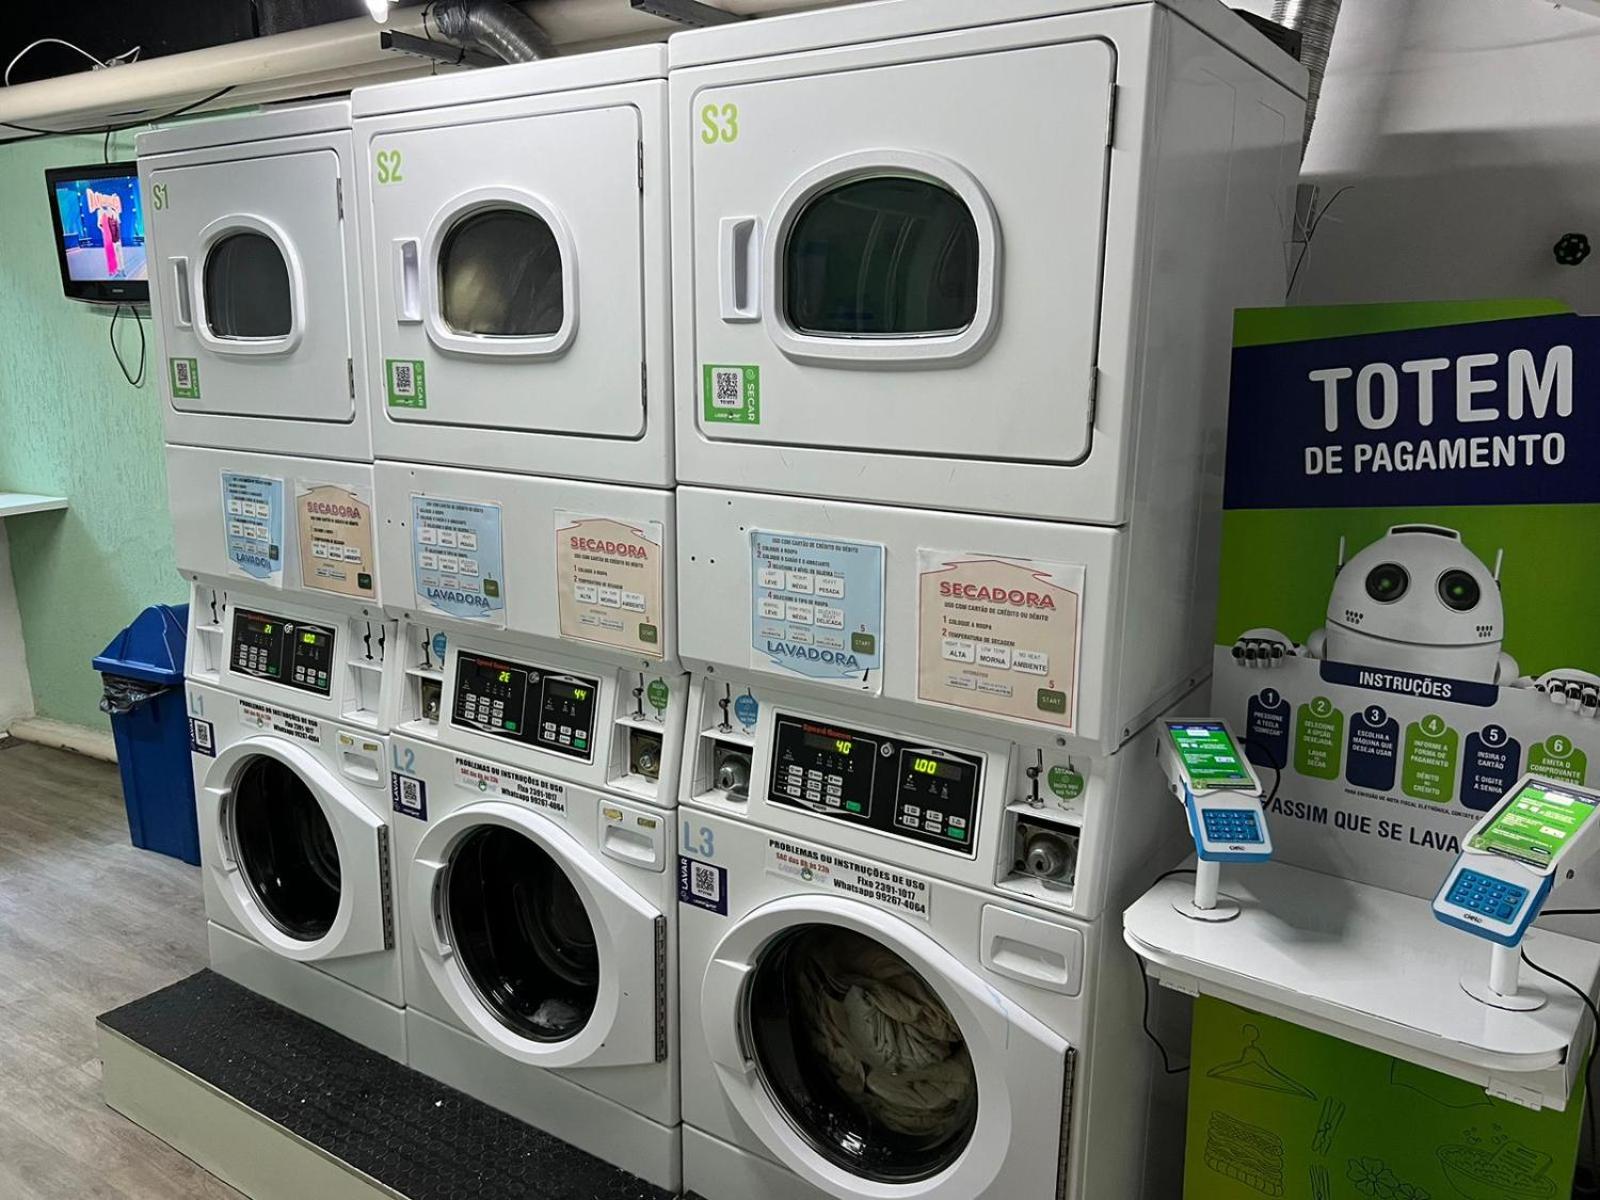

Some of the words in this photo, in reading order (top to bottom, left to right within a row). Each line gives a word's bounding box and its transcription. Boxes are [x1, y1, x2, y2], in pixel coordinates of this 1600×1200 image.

[701, 103, 738, 144] S3
[376, 150, 404, 185] S2
[153, 184, 169, 210] S1
[1307, 344, 1574, 433] TOTEM
[747, 383, 755, 421] SECAR
[1305, 445, 1343, 475] DE
[1354, 432, 1566, 474] PAGAMENTO
[306, 501, 361, 519] SECADORA
[570, 536, 648, 560] SECADORA
[427, 587, 490, 608] LAVADORA
[940, 581, 1056, 610] SECADORA
[943, 615, 947, 623] 1
[968, 604, 988, 613] CARTÃO
[997, 607, 1020, 618] CRÉDITO
[1029, 611, 1049, 621] DÉBITO
[860, 624, 865, 632] 5
[942, 628, 947, 636] 2
[767, 640, 860, 668] LAVADORA
[950, 650, 966, 659] ALTA
[980, 655, 1005, 665] MORNA
[1013, 660, 1047, 672] AMBIENTE
[1048, 680, 1055, 689] 5
[1359, 671, 1452, 698] INSTRUÇÕES
[574, 688, 587, 701] 44
[1042, 696, 1060, 705] START
[1267, 692, 1273, 703] 1
[190, 691, 204, 717] L1
[1317, 701, 1325, 712] 2
[1371, 709, 1379, 721] 3
[1304, 720, 1335, 731] SELECIONE
[1428, 719, 1437, 731] 4
[1357, 729, 1384, 740] ESCOLHA
[1489, 729, 1498, 742] 5
[836, 740, 852, 754] 40
[1353, 736, 1380, 747] MÁQUINA
[1553, 739, 1563, 752] 6
[1308, 750, 1326, 759] LAVAR
[1352, 744, 1375, 755] DESEJA
[1376, 748, 1392, 757] USAR
[1478, 751, 1501, 761] INSIRA
[393, 744, 416, 774] L2
[1410, 755, 1449, 767] PAGAMENTO
[1477, 759, 1504, 769] CARTÃO
[1542, 758, 1563, 767] EMITA
[455, 757, 490, 774] PROBLEMAS
[491, 767, 500, 776] OU
[500, 770, 540, 786] INSTRUÇÕES
[540, 780, 549, 789] DE
[549, 784, 563, 793] USO
[1416, 771, 1440, 782] DÉBITO
[1530, 764, 1581, 778] COMPROVANTE
[1481, 776, 1503, 785] DIGITE
[501, 787, 530, 802] Whatsapp
[517, 784, 529, 793] Fixo
[1413, 783, 1440, 795] CRÉDITO
[1480, 784, 1503, 794] SENHA
[1271, 798, 1328, 824] ASSIM
[1334, 811, 1372, 834] QUE
[1378, 819, 1403, 841] SE
[1410, 826, 1459, 854] LAVA
[684, 821, 714, 858] L3
[769, 839, 819, 860] PROBLEMAS
[820, 853, 832, 864] OU
[834, 857, 890, 881] INSTRUÇÕES
[892, 874, 905, 885] DE
[906, 878, 925, 891] USO
[776, 852, 787, 861] SAC
[788, 856, 799, 866] das
[857, 876, 874, 888] Fixo
[875, 881, 916, 901] 2391-1017
[833, 878, 875, 899] Whatsapp
[876, 890, 926, 914] 99267-4064
